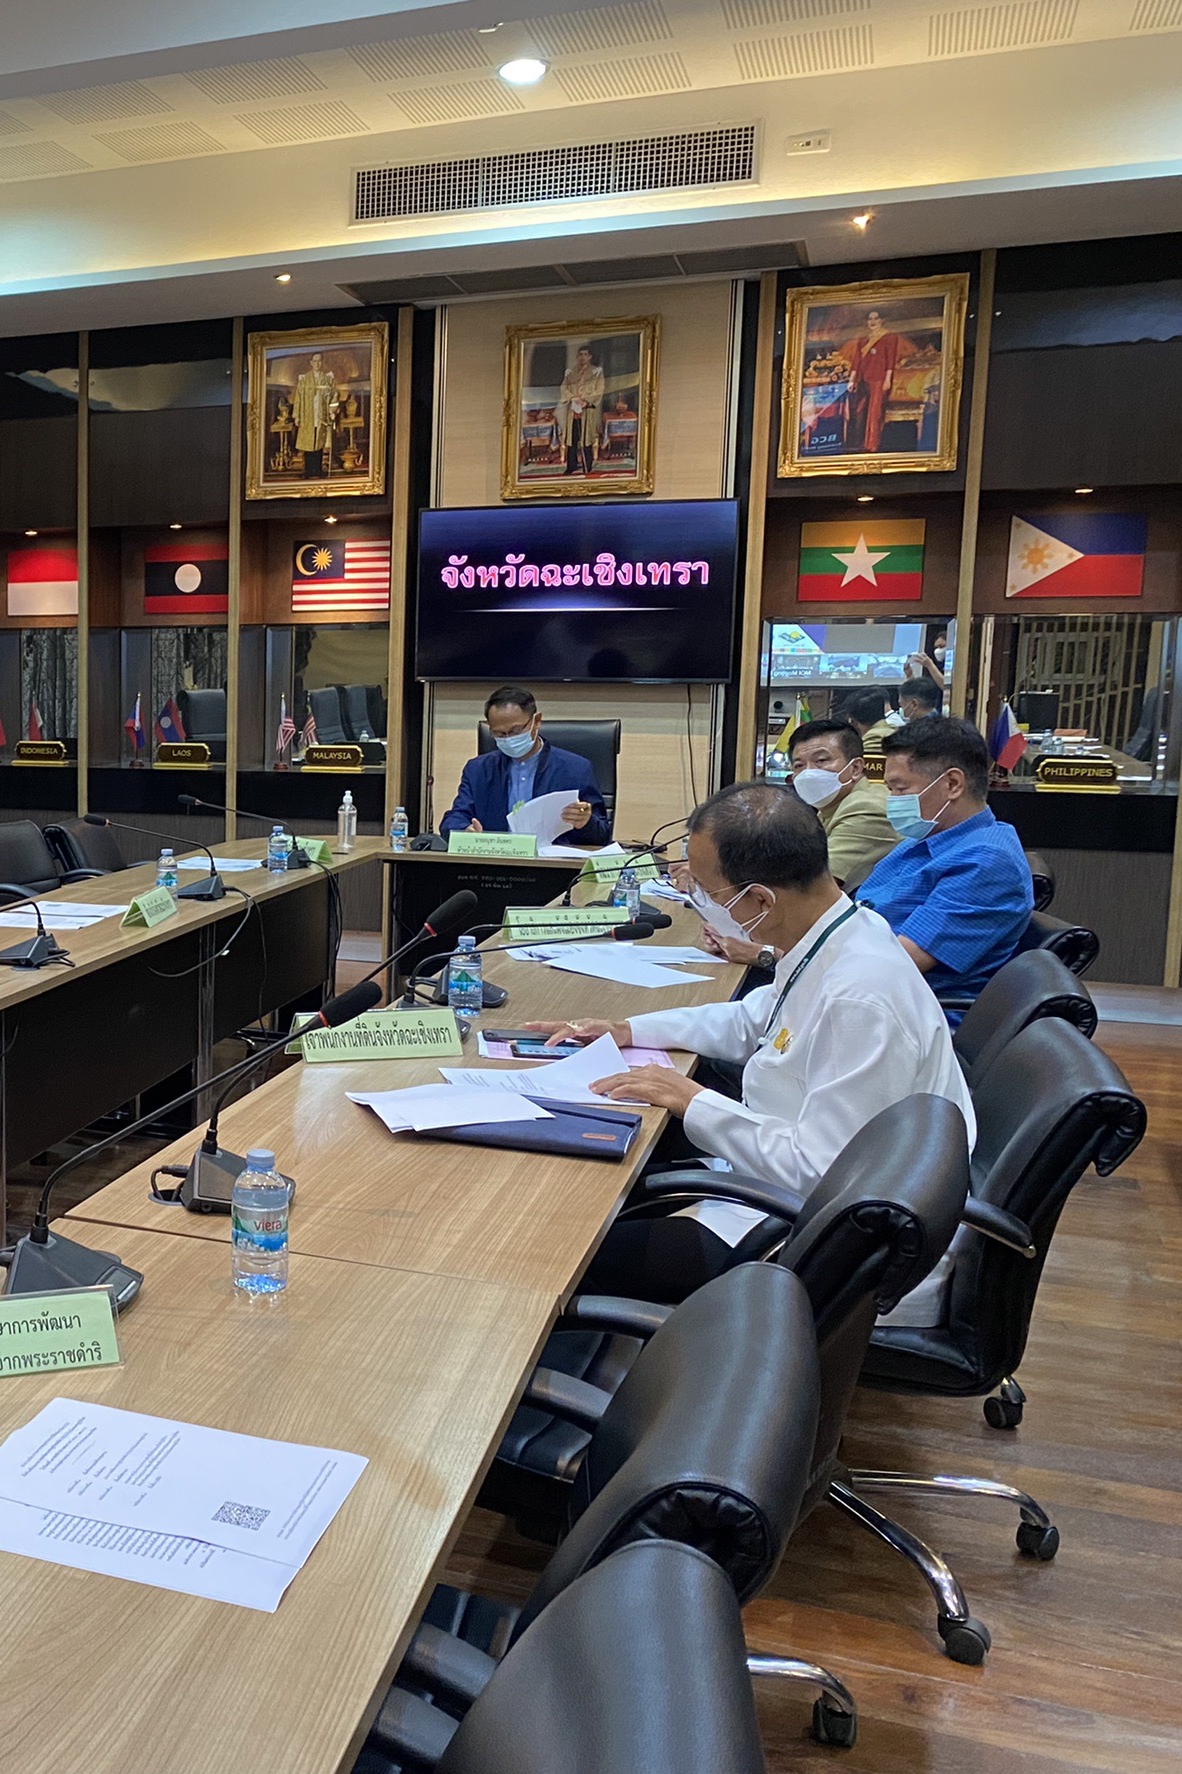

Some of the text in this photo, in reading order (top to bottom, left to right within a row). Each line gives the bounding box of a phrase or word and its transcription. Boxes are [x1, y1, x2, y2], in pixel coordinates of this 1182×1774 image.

[440, 552, 710, 589] จังหวัดฉะเชิงเทรา
[20, 747, 59, 755] INDONESIA
[172, 749, 192, 757] LAOS
[312, 752, 352, 760] MALAYSIA
[863, 762, 884, 771] MAR
[1044, 767, 1114, 777] PHILIPPINES
[305, 1017, 453, 1050] เจาพนกงานที่ดินจังหวัดฉะเชิงเทรา
[254, 1219, 282, 1232] viera
